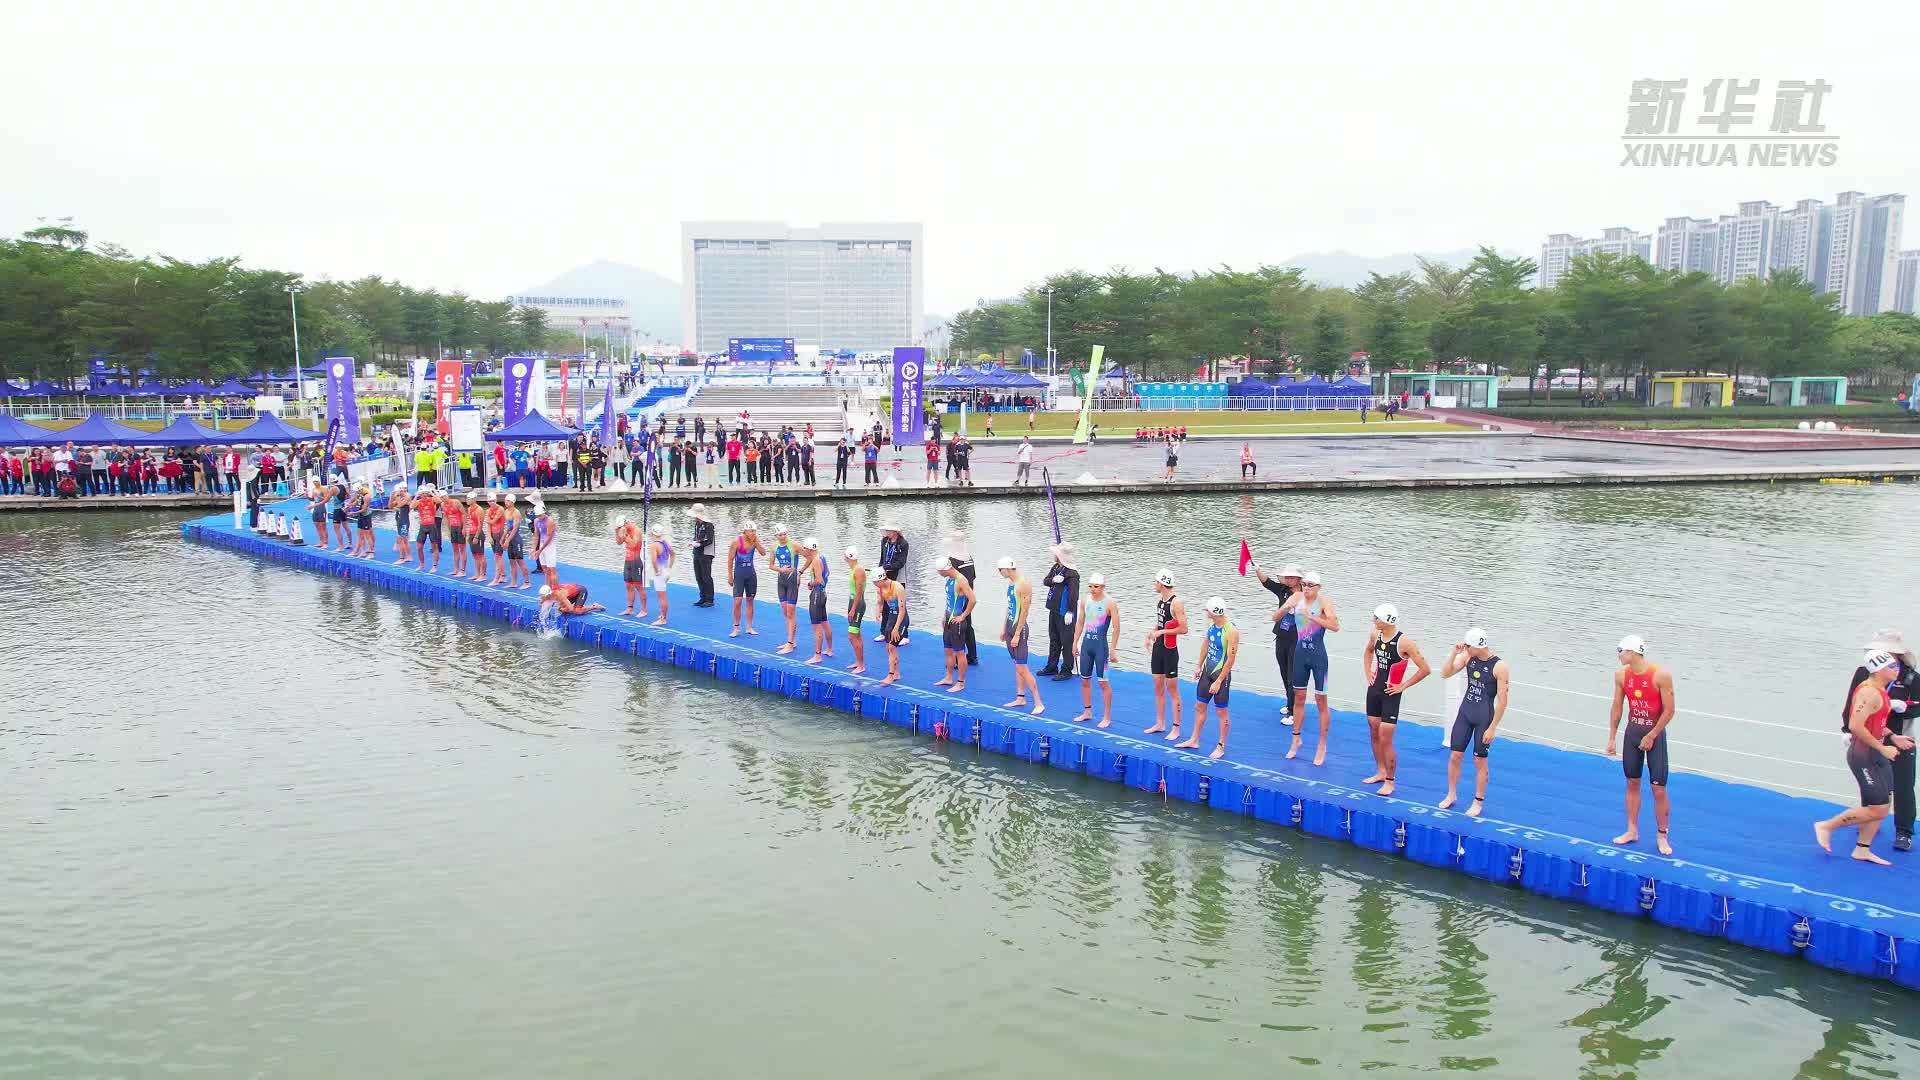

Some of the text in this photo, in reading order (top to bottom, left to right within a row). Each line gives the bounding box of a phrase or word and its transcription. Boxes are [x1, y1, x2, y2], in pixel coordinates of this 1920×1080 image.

[1161, 575, 1172, 585] 23
[1633, 708, 1649, 718] CHN
[1325, 788, 1368, 800] 35
[1407, 806, 1453, 819] 36
[1495, 827, 1545, 841] 37
[1596, 848, 1648, 863] 38
[1705, 872, 1761, 889] 39
[1828, 900, 1894, 918] 40
